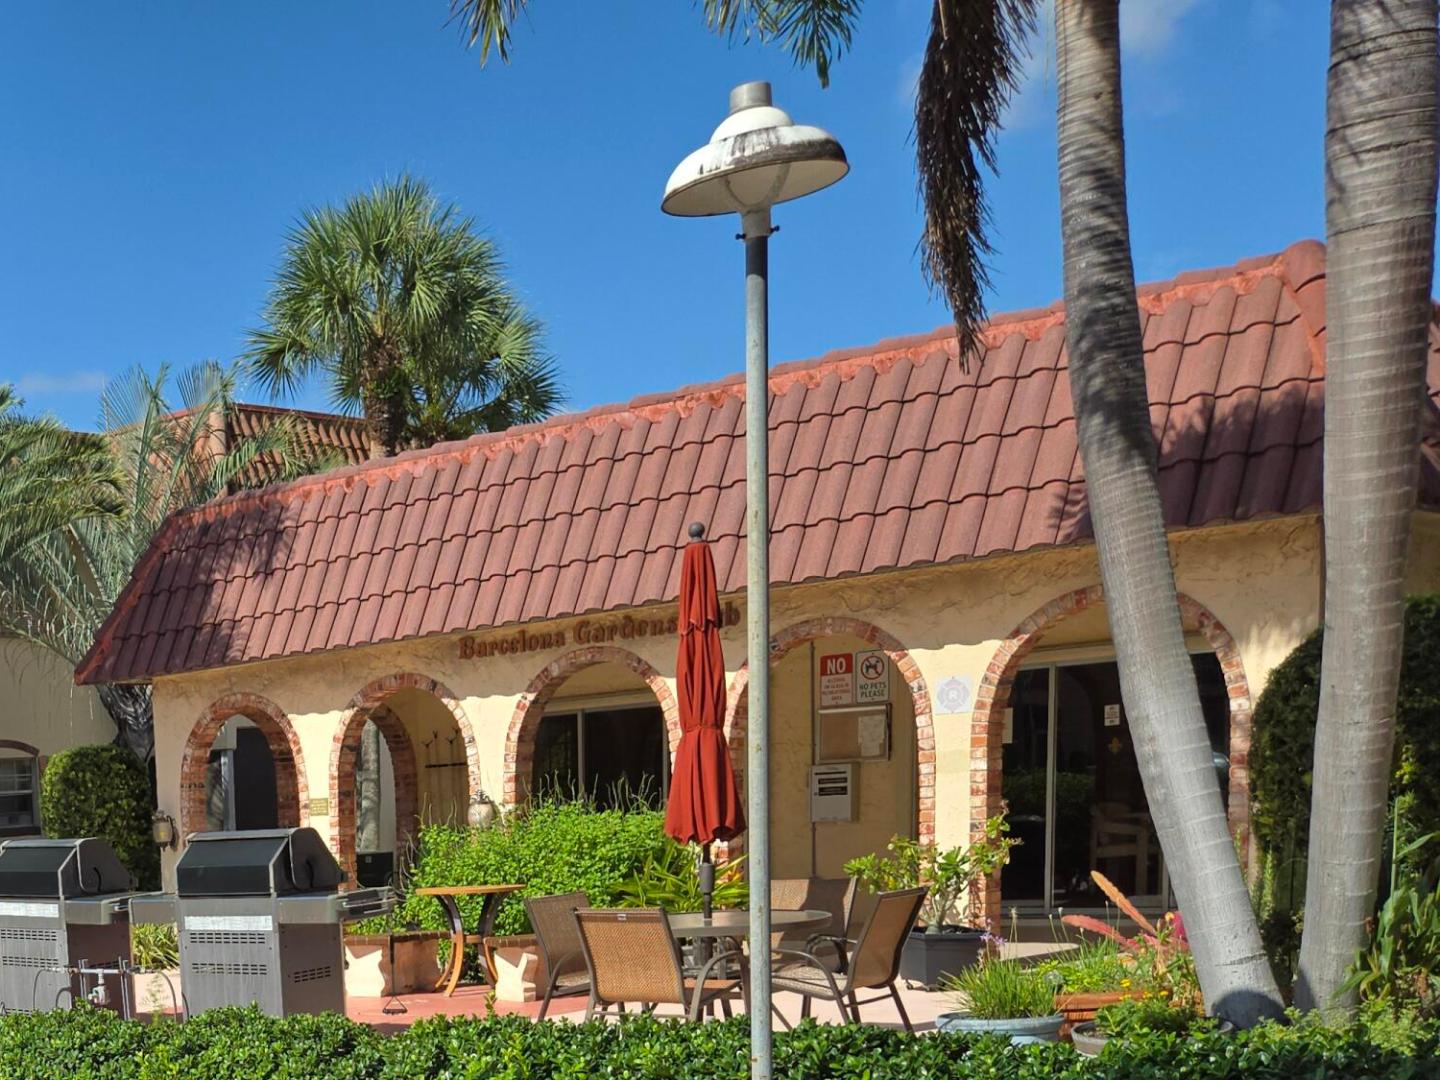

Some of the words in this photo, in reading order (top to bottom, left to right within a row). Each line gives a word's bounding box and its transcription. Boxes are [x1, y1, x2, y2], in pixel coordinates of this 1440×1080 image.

[459, 629, 566, 660] Barcelona
[573, 615, 677, 645] Gardens
[827, 657, 846, 675] NO
[860, 683, 869, 691] NO
[870, 681, 886, 690] PETS
[861, 688, 885, 699] PLEASE
